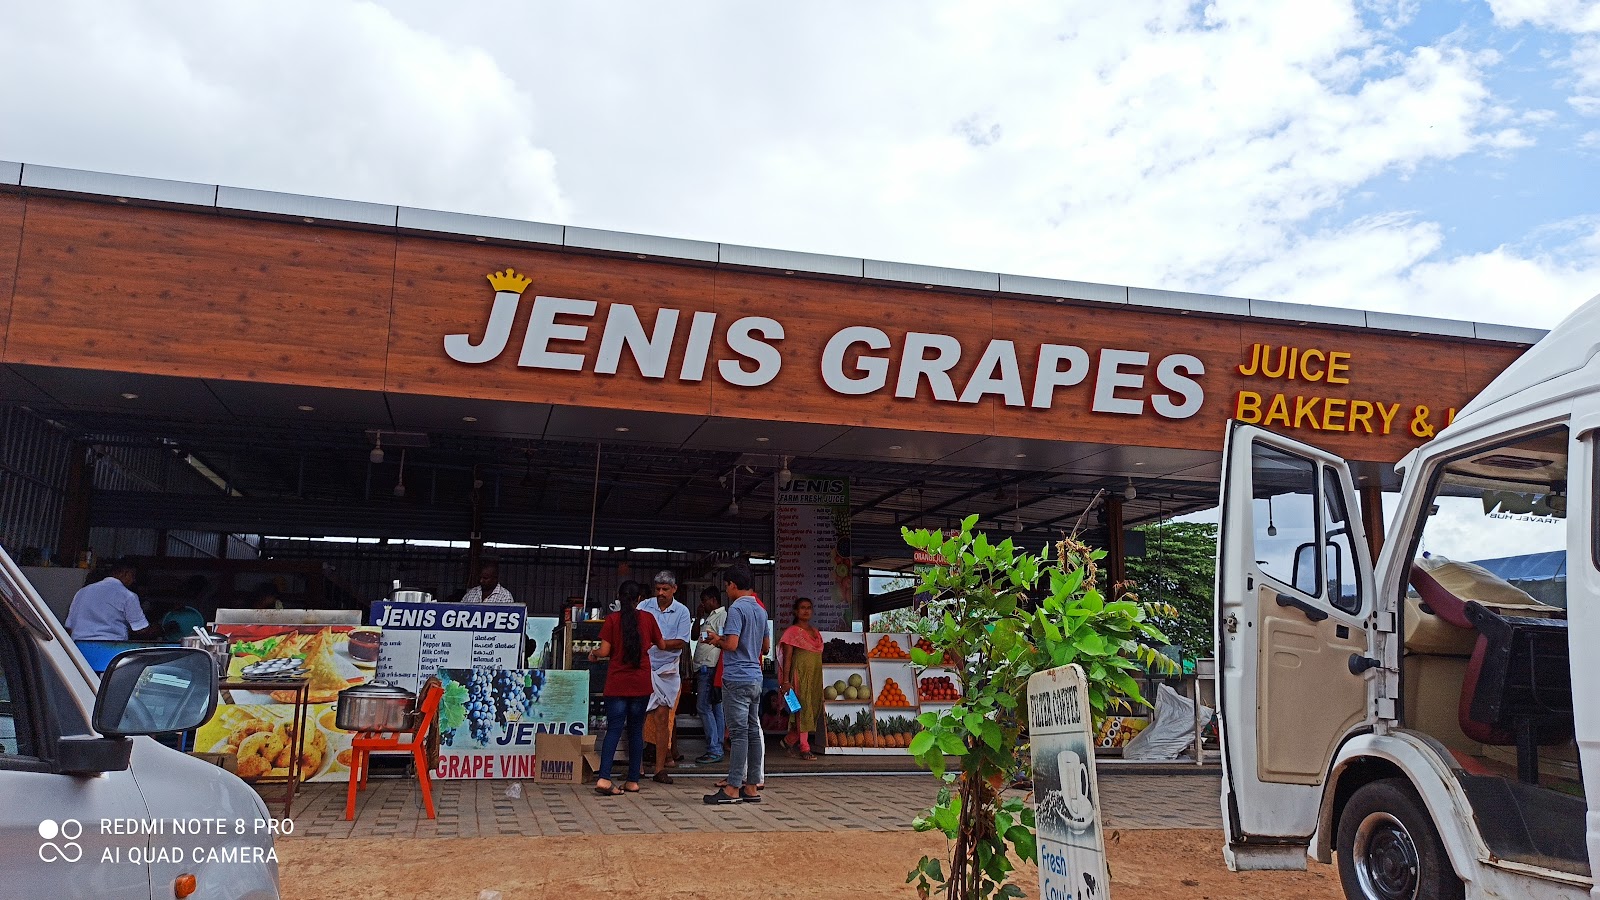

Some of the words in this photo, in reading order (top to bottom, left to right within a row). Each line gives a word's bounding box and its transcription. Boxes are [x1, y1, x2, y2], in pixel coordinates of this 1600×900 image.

[443, 291, 785, 387] JENIS
[820, 325, 1205, 419] GRAPES
[1237, 343, 1351, 385] JUICE
[1234, 390, 1400, 436] BAKERY
[1409, 404, 1434, 438] &
[779, 479, 843, 494] JENIS
[779, 494, 799, 503] FARM
[800, 494, 822, 503] FRESH
[823, 495, 845, 504] JUICE
[376, 607, 436, 627] JENIS
[441, 610, 520, 630] GRAPES
[1030, 691, 1053, 728] FILTER
[1052, 685, 1081, 727] COFFEE
[436, 755, 494, 778] GRAPE
[541, 760, 573, 773] NAVIN
[1041, 844, 1067, 877] Fresh
